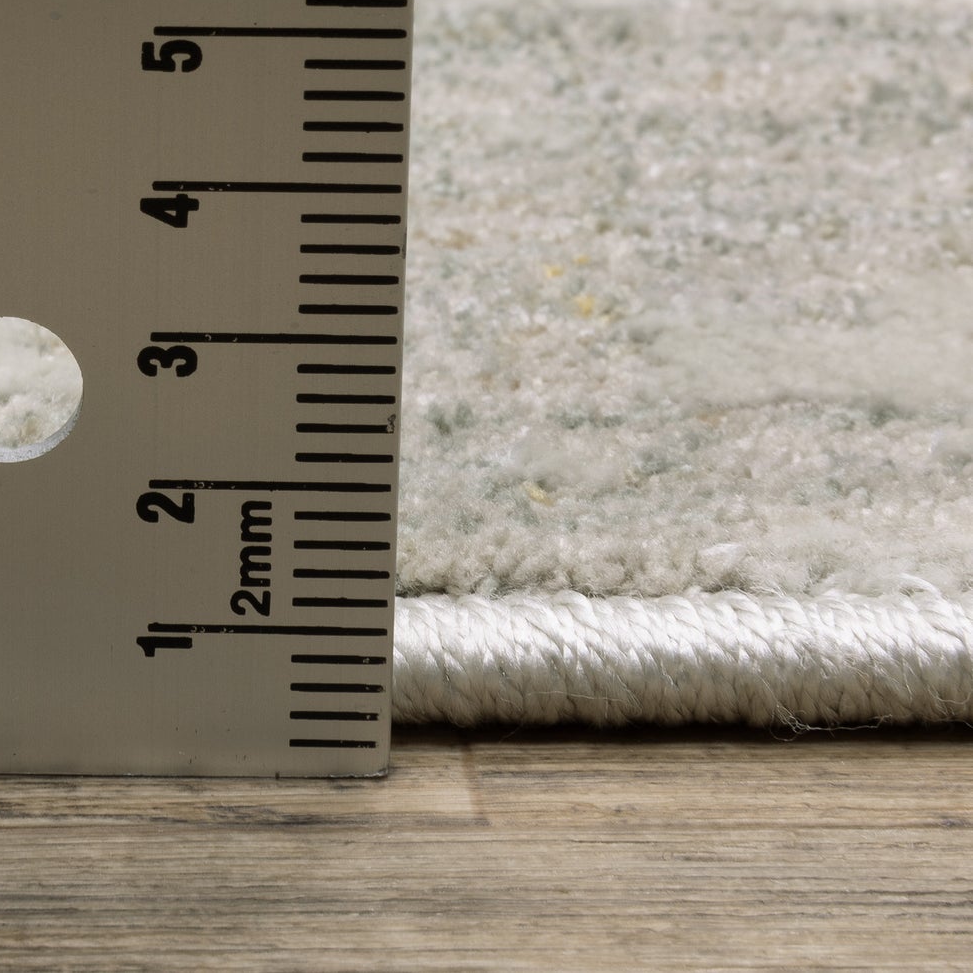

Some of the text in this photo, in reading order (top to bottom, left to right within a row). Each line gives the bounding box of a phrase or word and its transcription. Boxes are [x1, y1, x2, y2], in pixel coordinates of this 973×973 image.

[141, 40, 202, 72] 5
[140, 194, 199, 228] 4
[137, 345, 197, 377] 3
[136, 492, 195, 523] 2
[230, 501, 272, 616] 2mm
[136, 636, 192, 657] 1
